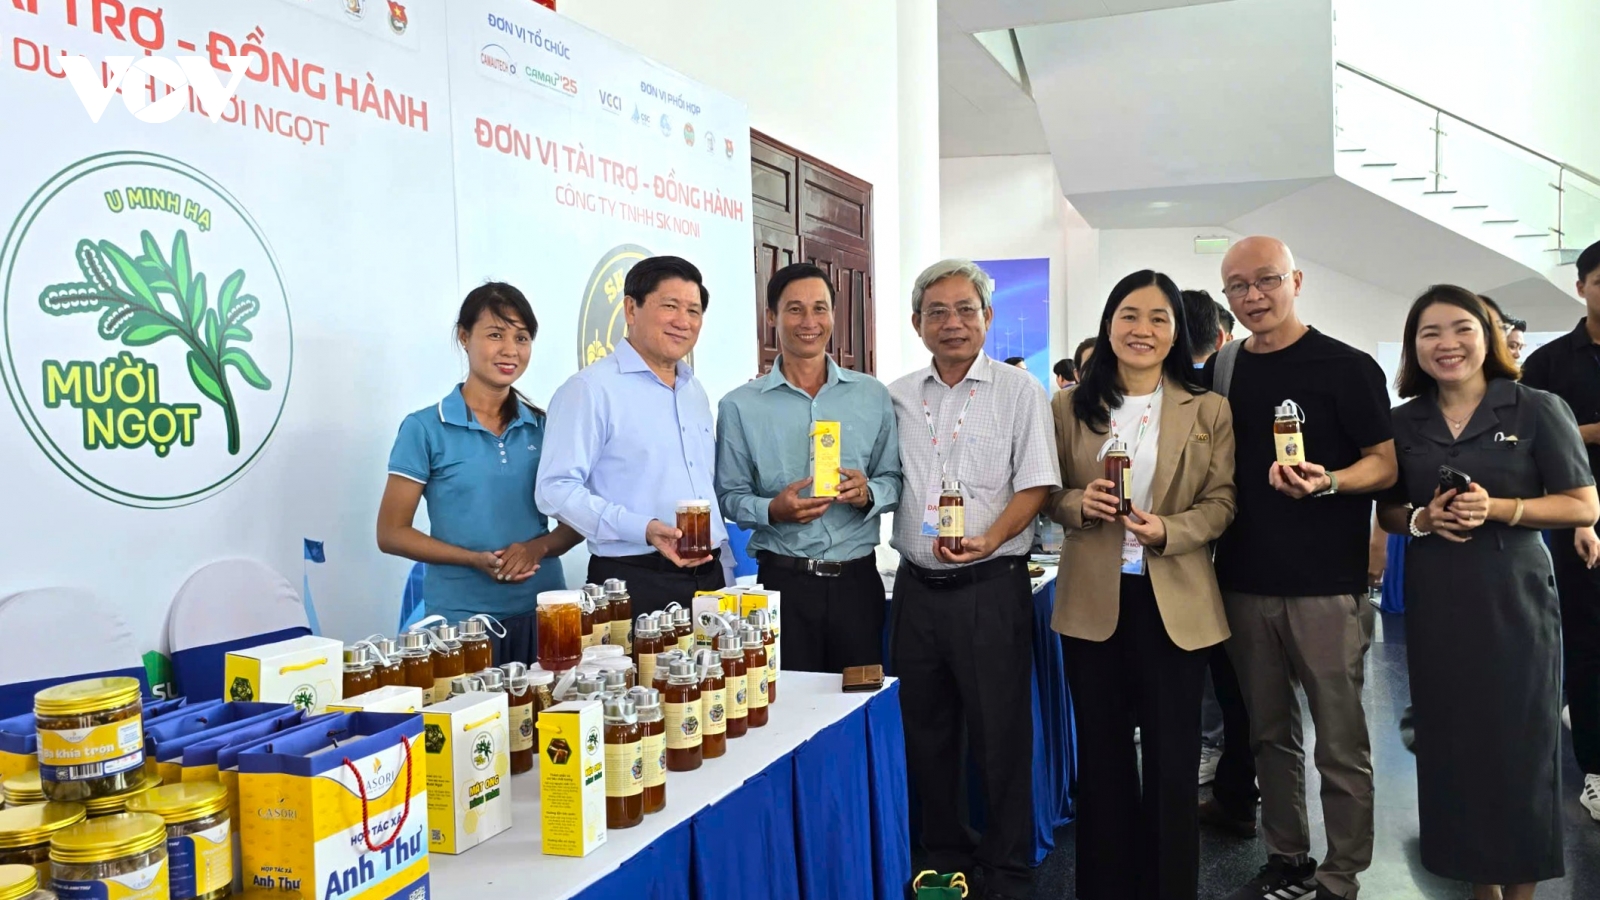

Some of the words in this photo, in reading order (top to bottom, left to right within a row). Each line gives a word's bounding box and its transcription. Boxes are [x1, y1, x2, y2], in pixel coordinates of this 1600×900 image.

[487, 13, 513, 36] ĐƠN
[527, 29, 543, 47] TỔ
[544, 41, 571, 60] CHỨC
[205, 25, 326, 100] ĐỒNG
[335, 71, 429, 132] HÀNH
[598, 89, 622, 112] VCCI
[640, 81, 658, 98] ĐƠN
[254, 103, 330, 146] NGỌT
[474, 117, 531, 161] ĐƠN
[535, 136, 558, 173] VỊ
[562, 142, 595, 179] TÀI
[598, 156, 639, 195] TRỢ
[653, 168, 701, 210] ĐỒNG
[703, 187, 744, 222] HÀNH
[104, 190, 124, 213] U
[126, 187, 180, 214] MINH
[184, 197, 212, 232] HẠ
[555, 182, 596, 212] CÔNG
[598, 196, 617, 217] TY
[619, 202, 654, 227] TNHH
[656, 211, 672, 231] SK
[673, 216, 701, 238] NONI
[46, 355, 157, 405] MƯỜI
[86, 407, 198, 454] NGỌT
[366, 770, 396, 791] ASORI
[484, 774, 500, 790] ONG
[257, 807, 298, 819] CASORI
[371, 820, 389, 836] TÁC
[390, 811, 404, 827] XÃ
[253, 874, 275, 889] Anh
[278, 876, 302, 890] Thư
[324, 853, 375, 900] Anh
[381, 823, 423, 871] Thư
